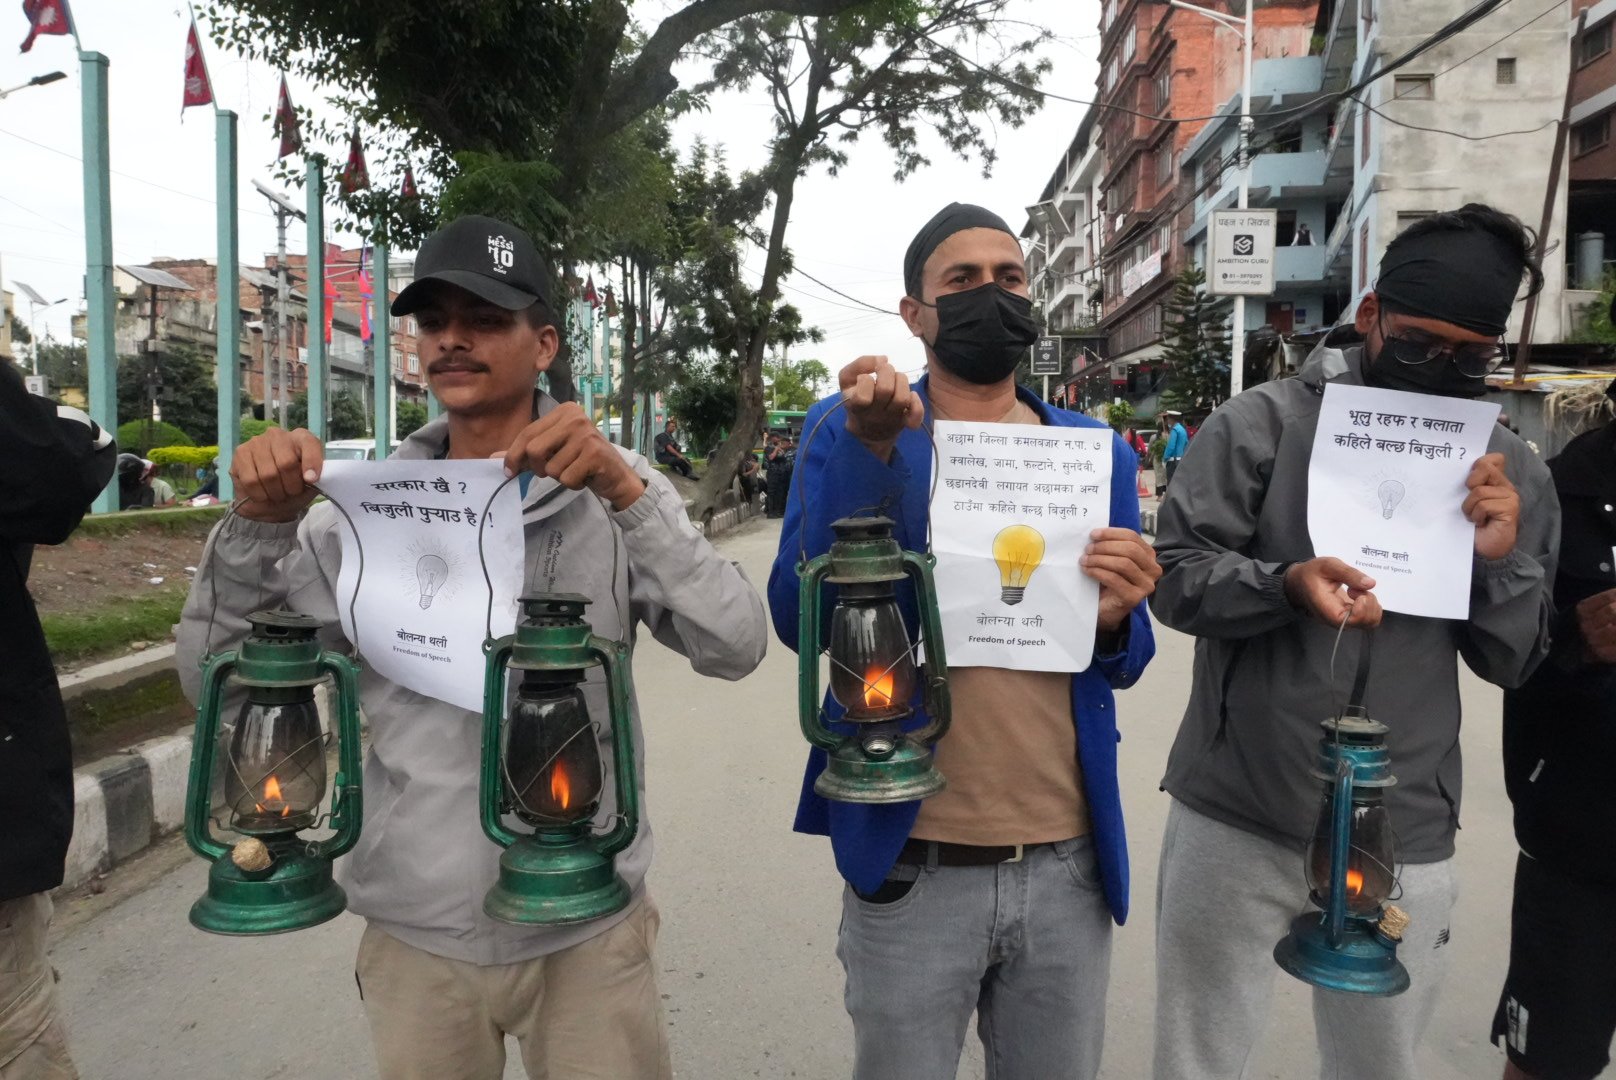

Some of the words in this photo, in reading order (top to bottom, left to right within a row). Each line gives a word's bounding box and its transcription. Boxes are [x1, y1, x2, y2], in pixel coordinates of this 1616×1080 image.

[488, 239, 513, 251] MESSI
[1349, 410, 1372, 427] भूलु
[1410, 416, 1418, 429] र
[946, 433, 974, 445] अछाम
[979, 432, 1007, 446] जिल्ला
[1013, 436, 1060, 449] कमलबजार
[1093, 441, 1101, 451] ७
[1334, 432, 1372, 450] कहिले
[1375, 438, 1406, 453] बल्छ
[1409, 438, 1453, 460] बिजुली
[371, 479, 428, 492] सरकार
[430, 477, 451, 494] खै
[996, 480, 1029, 494] लगायत
[1033, 483, 1073, 495] अछामका
[1079, 485, 1099, 495] अन्य
[360, 501, 414, 518] बिजुली
[463, 507, 478, 527] है
[988, 501, 1016, 514] कहिले
[1022, 505, 1043, 517] बल्छ
[1048, 503, 1078, 519] बिजुली
[1355, 560, 1382, 570] Freedom
[1390, 565, 1412, 575] Speech
[976, 613, 1015, 627] बोलन्या
[1021, 614, 1044, 628] थली
[396, 628, 426, 645] बोलन्या
[429, 635, 447, 648] थली
[968, 635, 1004, 644] Freedom
[1017, 638, 1046, 647] Speech
[392, 645, 420, 657] Freedom
[428, 652, 452, 663] Speech
